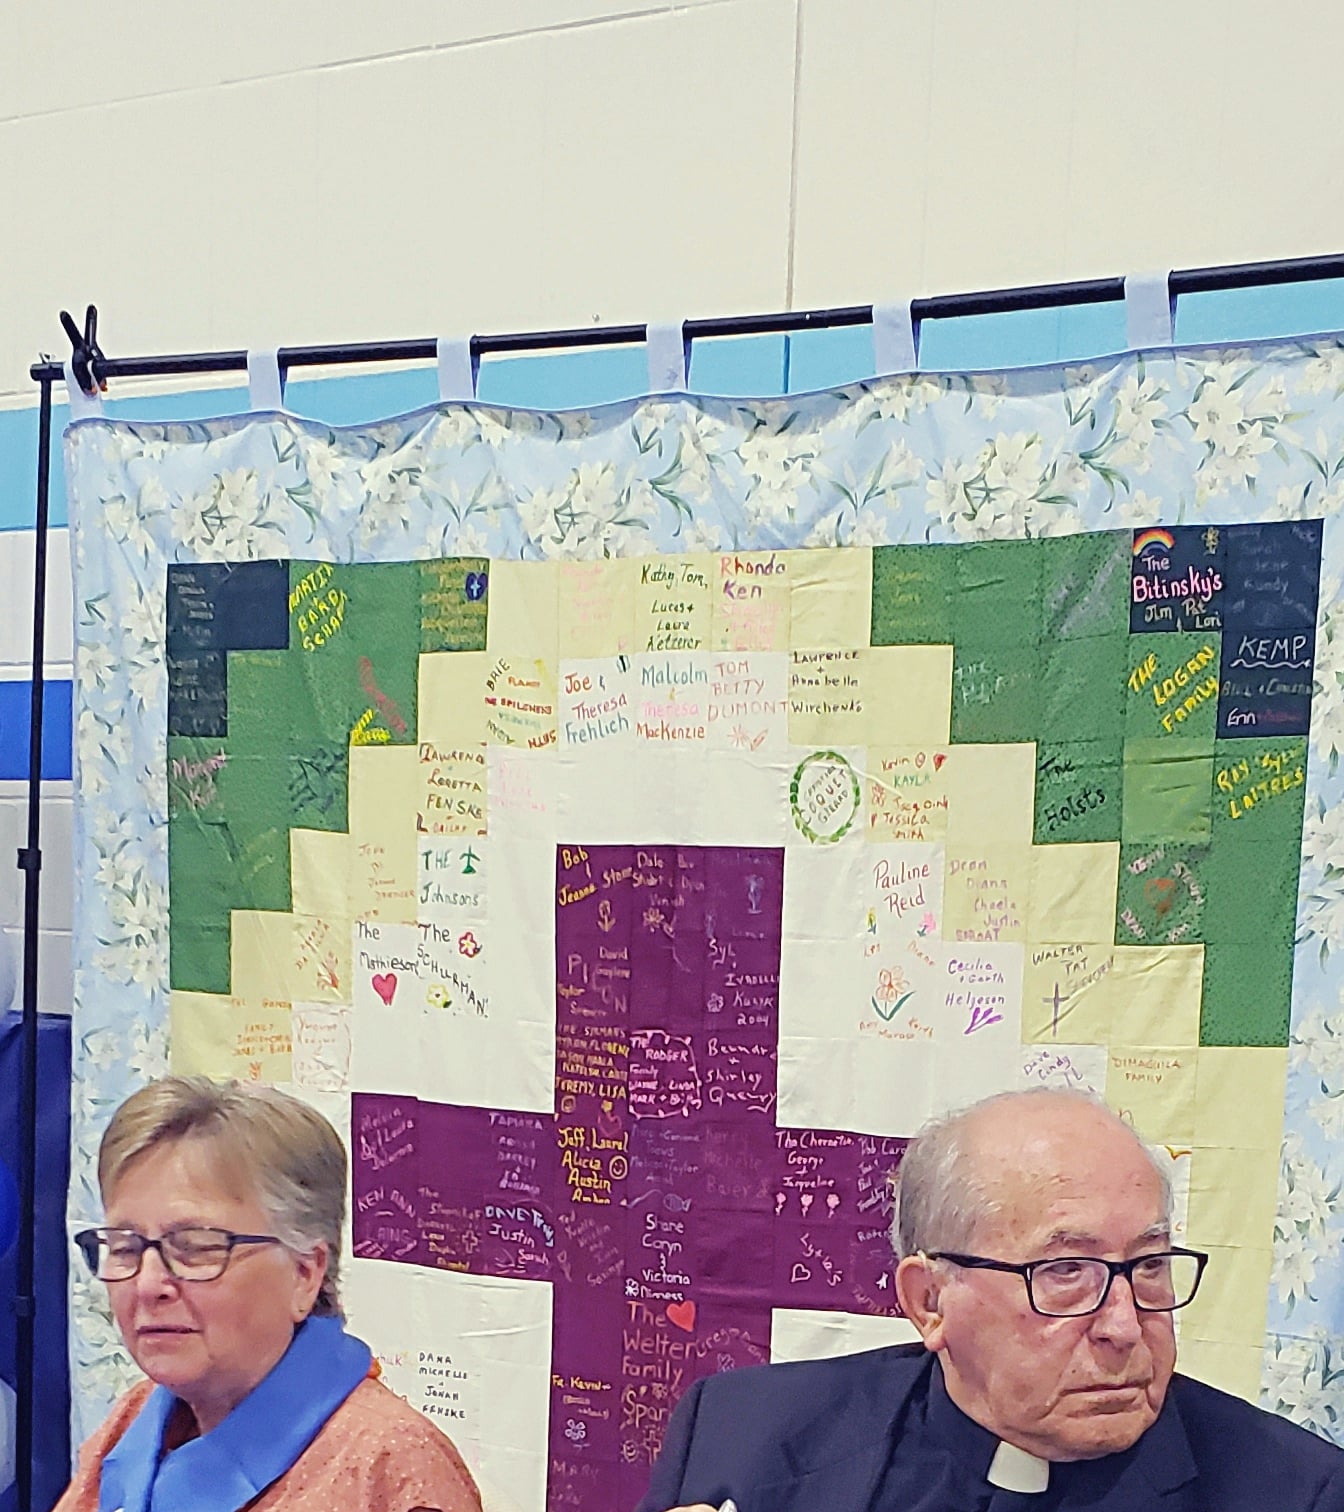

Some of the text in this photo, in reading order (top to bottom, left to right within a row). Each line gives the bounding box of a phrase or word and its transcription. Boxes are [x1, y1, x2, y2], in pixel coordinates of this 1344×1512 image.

[719, 553, 787, 578] Rhonda
[723, 580, 763, 600] Ken
[1195, 611, 1223, 629] Lori
[1238, 636, 1307, 661] KEMP
[641, 663, 708, 687] Malcolm
[715, 659, 750, 675] TOM
[1128, 652, 1157, 693] THE
[1153, 645, 1216, 707] LOGAN
[564, 673, 593, 694] Joe
[711, 679, 765, 697] BETTY
[572, 693, 628, 721] Theresa
[643, 702, 700, 718] Theresa
[707, 701, 788, 722] DUMONT
[423, 850, 453, 872] THE
[561, 847, 589, 870] Bob
[873, 859, 931, 890] Pauline
[883, 883, 926, 919] Reid
[358, 921, 380, 941] The
[418, 923, 451, 944] The
[1031, 944, 1085, 966] WALTER
[736, 1013, 770, 1028] 2004
[1037, 1055, 1072, 1081] Cindy
[706, 1068, 762, 1091] Shirley
[598, 1083, 627, 1101] LISA
[562, 1150, 602, 1171] Alicia
[787, 1150, 825, 1170] George
[568, 1168, 612, 1193] Austin
[485, 1205, 530, 1221] DAVE
[489, 1223, 536, 1248] Justin
[641, 1269, 692, 1285] Victoria
[627, 1300, 667, 1327] The
[622, 1329, 698, 1360] Welter
